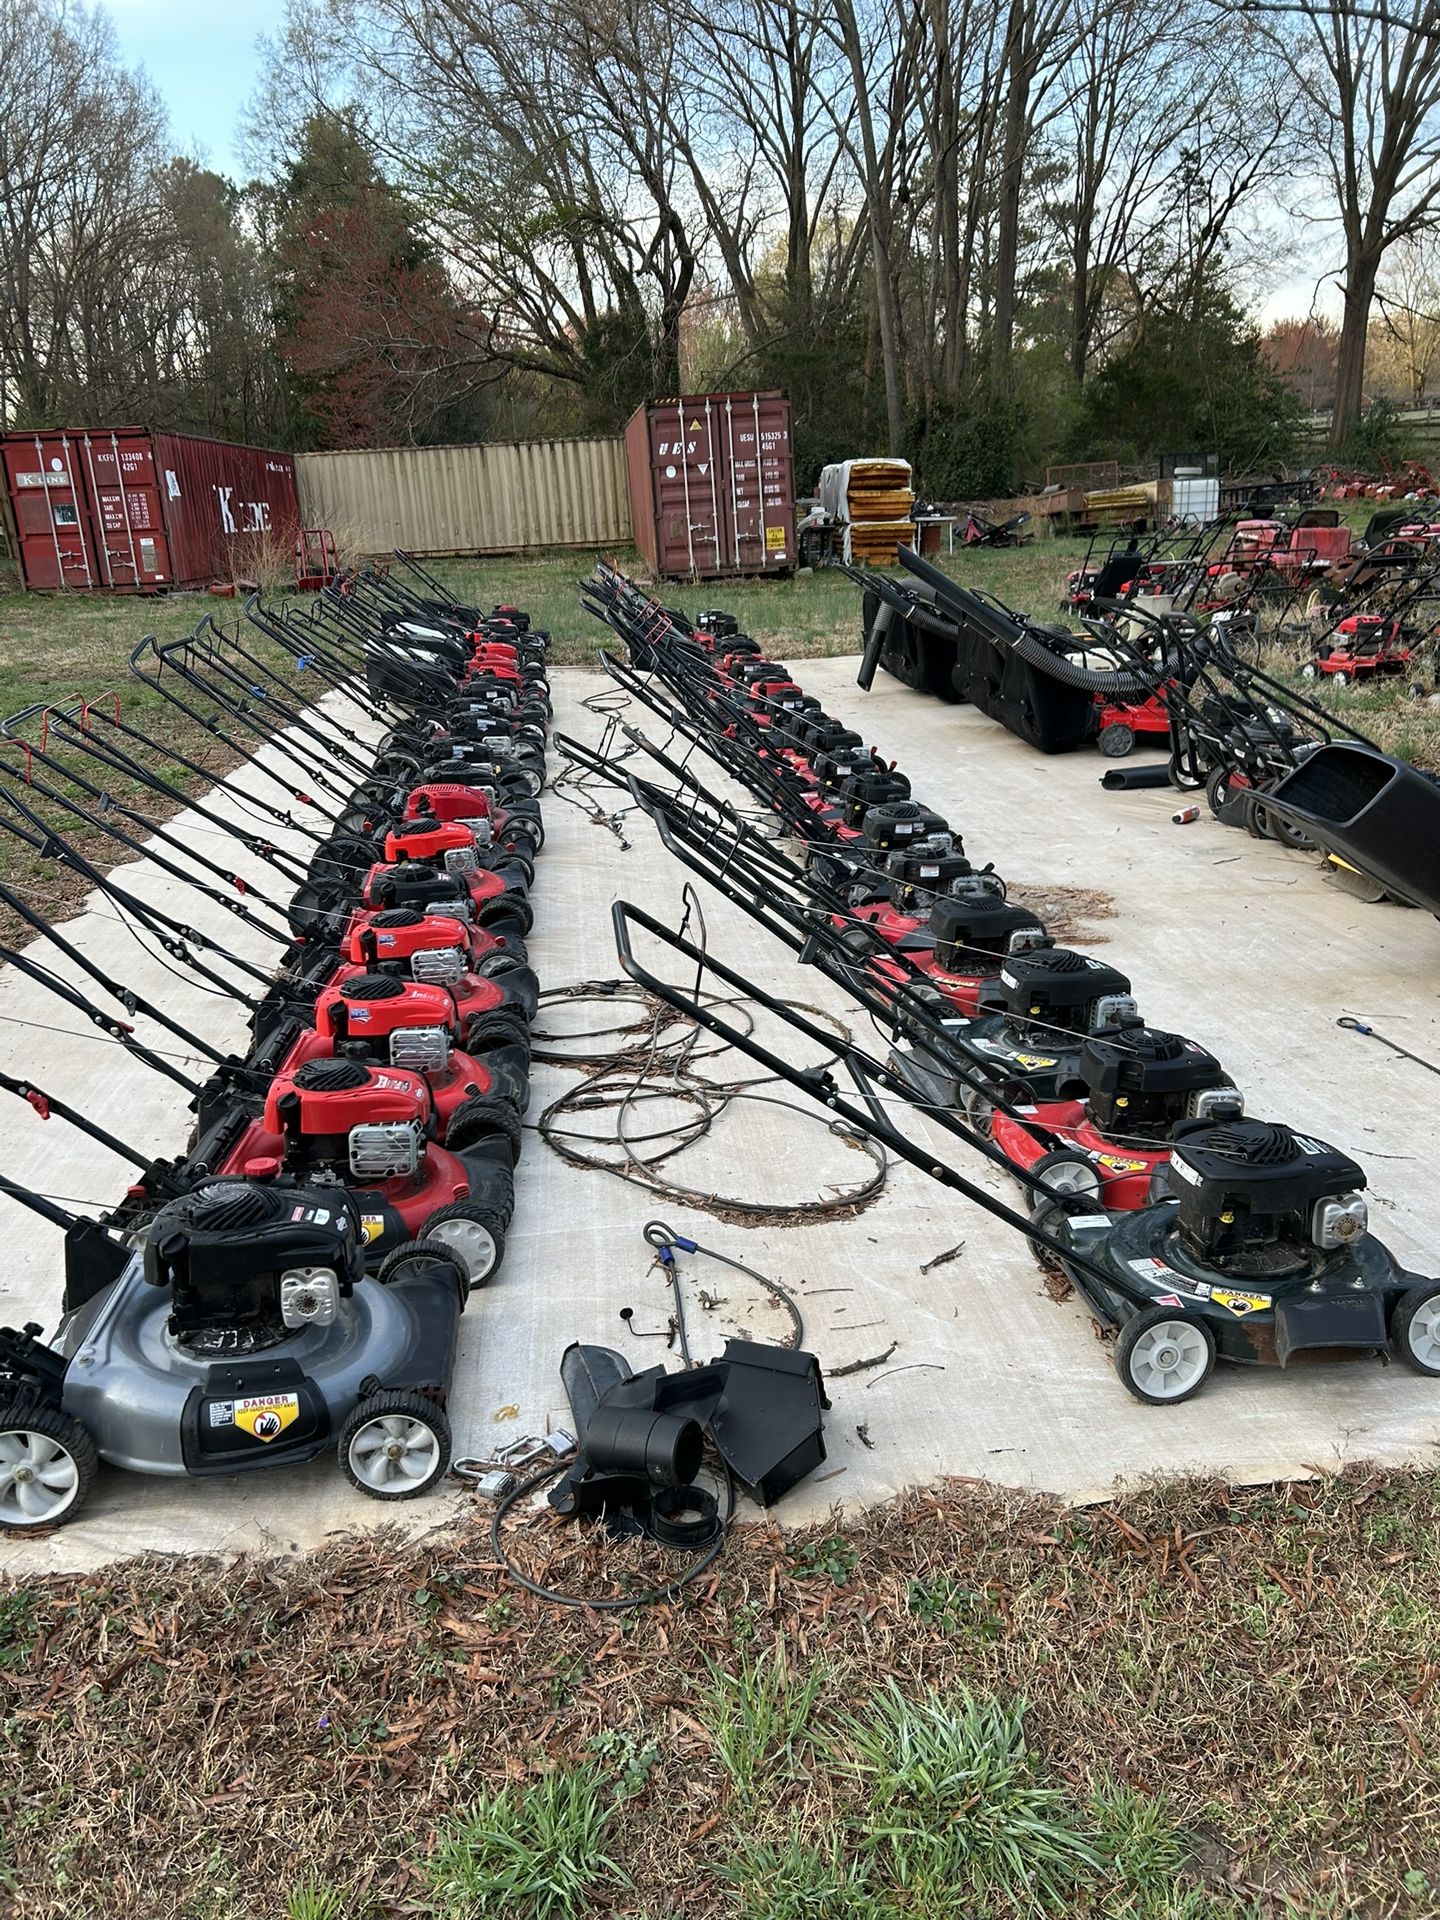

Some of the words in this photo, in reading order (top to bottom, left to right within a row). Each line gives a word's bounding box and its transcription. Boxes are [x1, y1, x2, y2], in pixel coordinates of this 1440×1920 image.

[740, 433, 754, 442] UESU
[760, 432, 781, 440] 515325
[761, 442, 776, 451] 45G1
[97, 453, 115, 462] KKFU
[120, 452, 144, 461] 133408
[122, 462, 138, 471] 42G1
[23, 475, 34, 484] K
[38, 476, 67, 484] LINE
[1221, 1289, 1262, 1300] DANGER
[243, 1395, 289, 1408] DANGER
